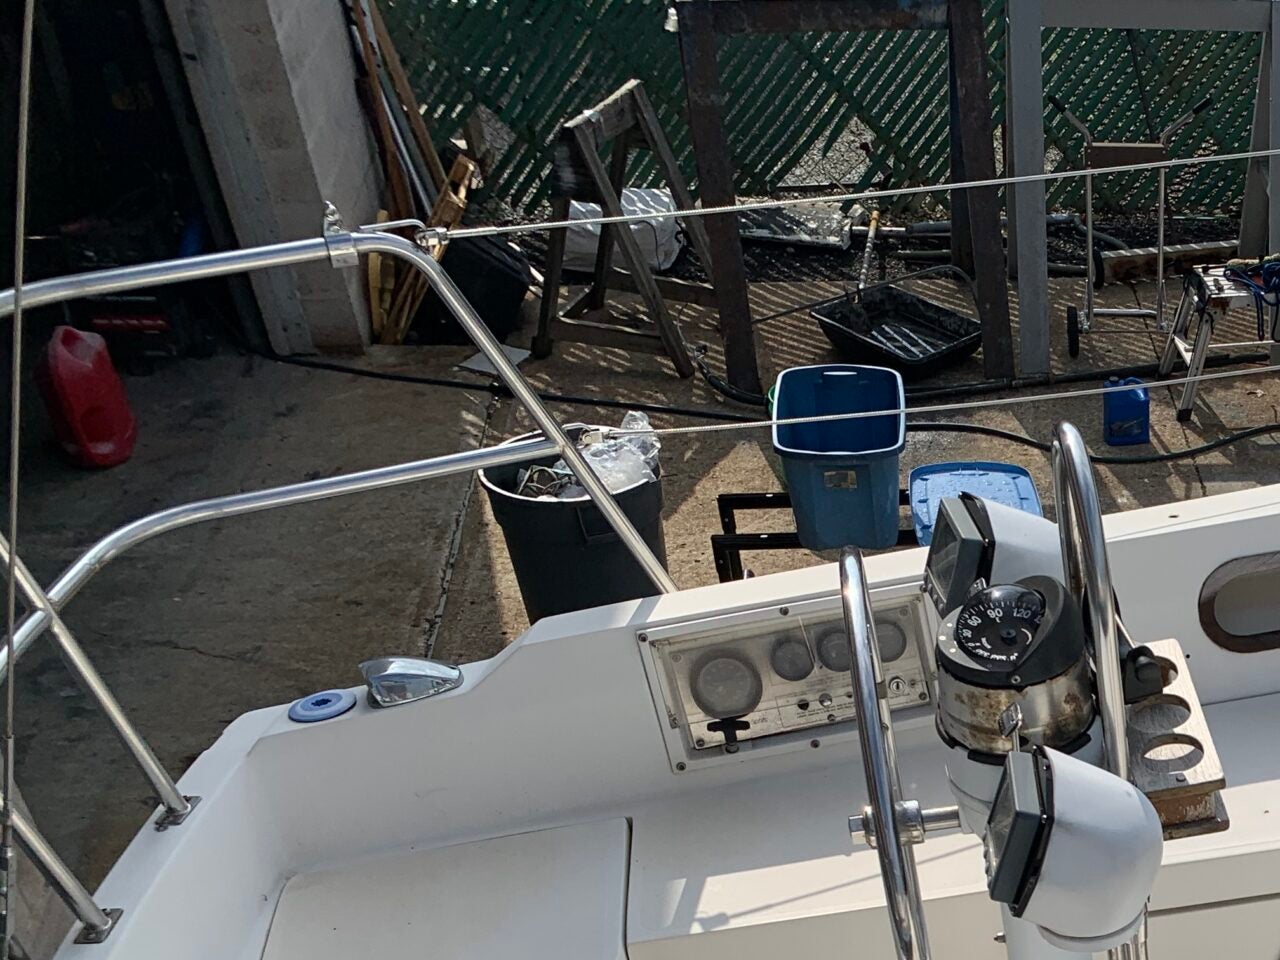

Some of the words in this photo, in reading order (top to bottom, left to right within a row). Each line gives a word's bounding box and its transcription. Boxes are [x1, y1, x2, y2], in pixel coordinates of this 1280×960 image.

[986, 608, 1003, 618] 90
[1012, 608, 1031, 619] 120
[967, 616, 982, 627] 60
